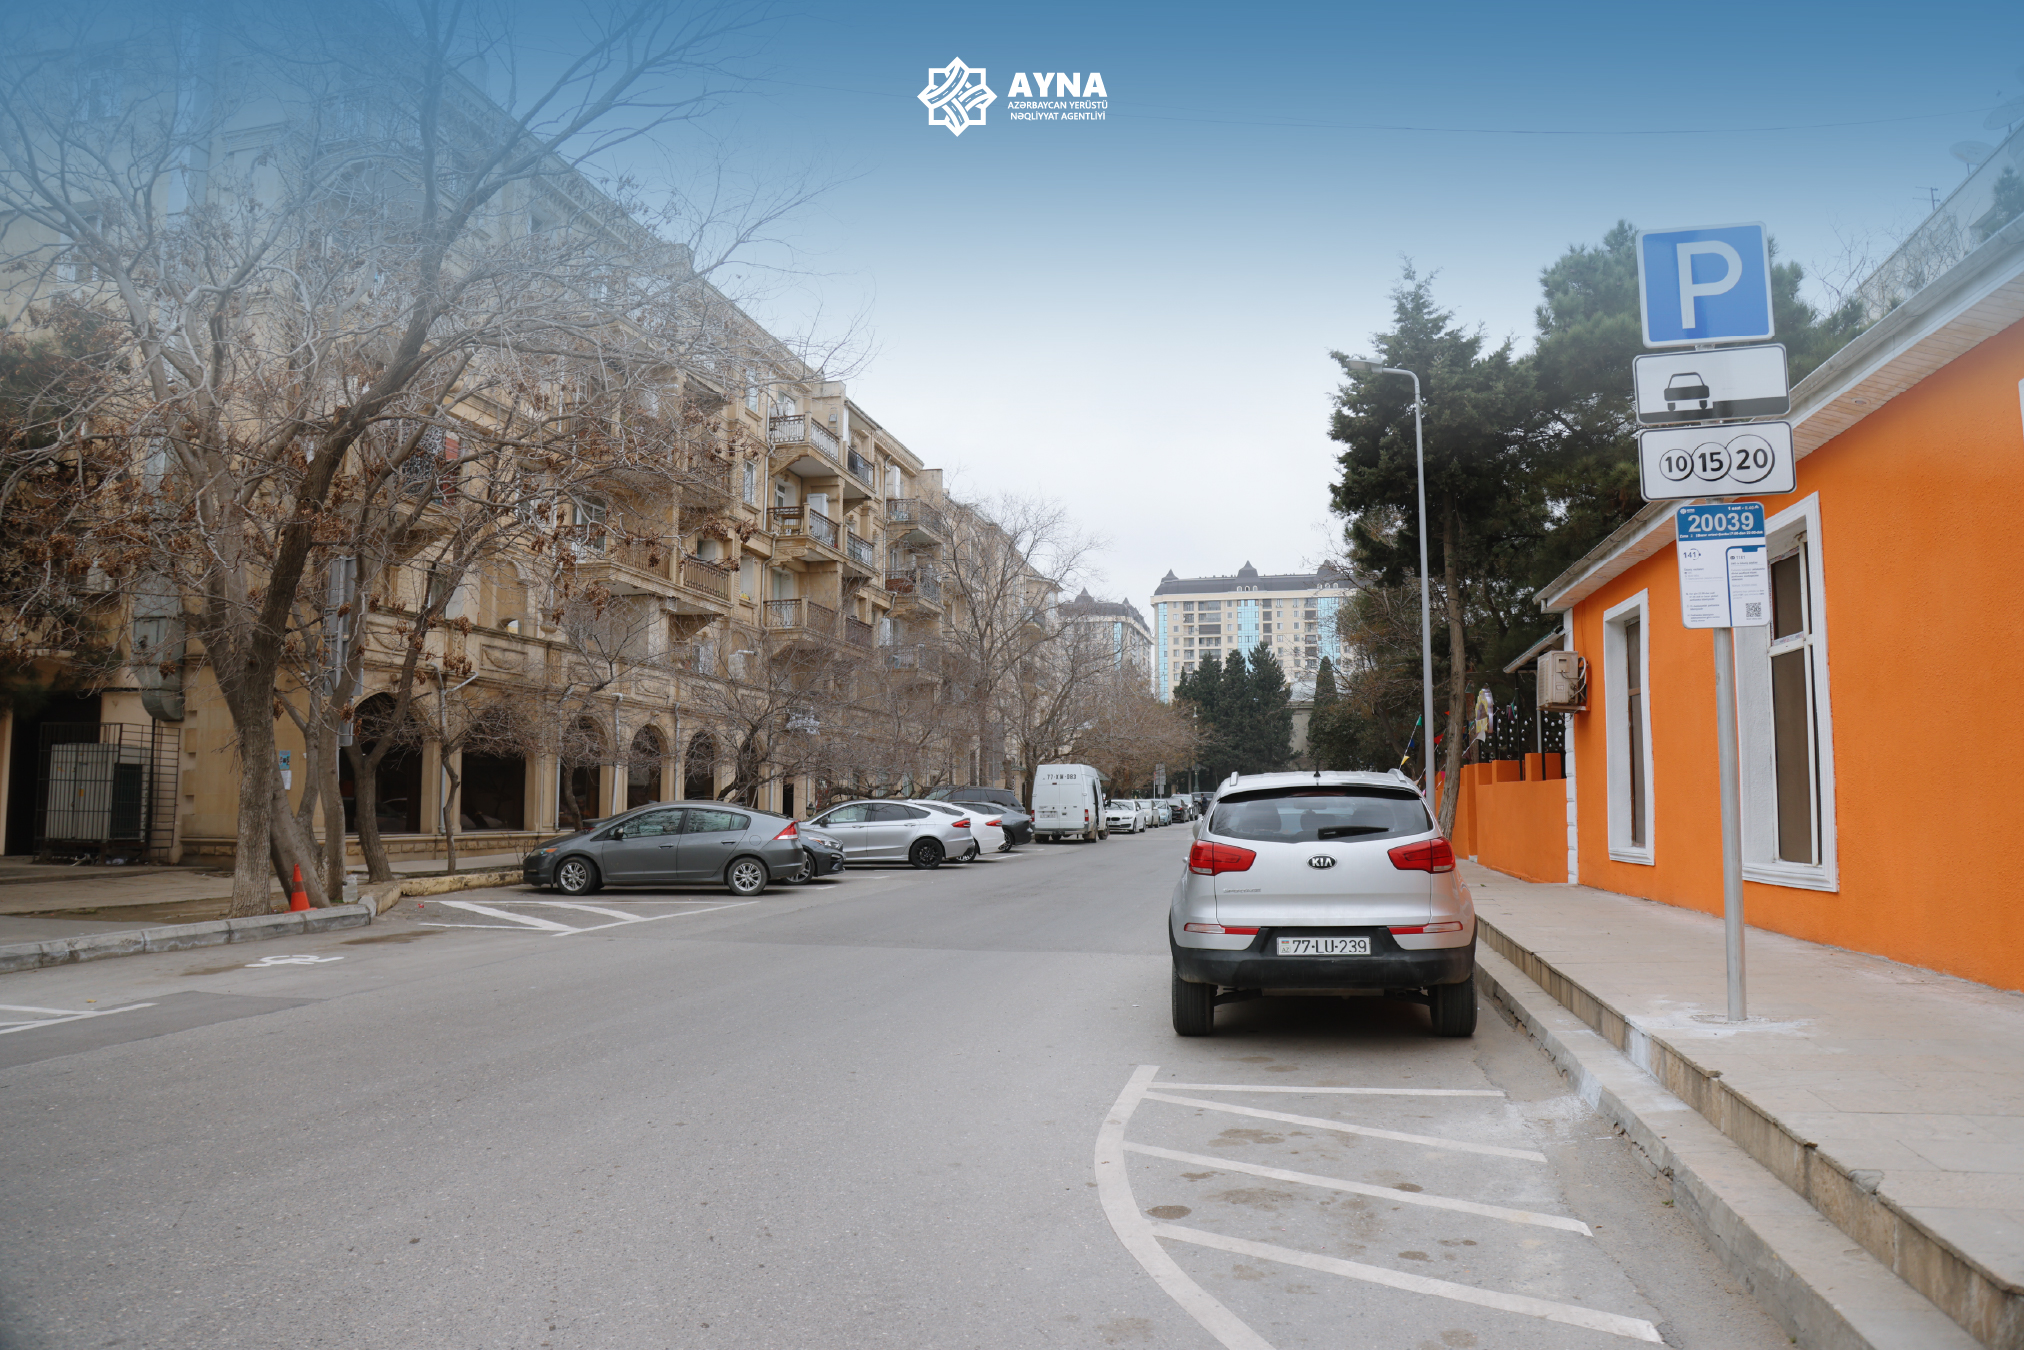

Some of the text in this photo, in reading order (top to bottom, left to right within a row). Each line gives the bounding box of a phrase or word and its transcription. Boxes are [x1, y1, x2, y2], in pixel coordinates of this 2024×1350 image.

[1676, 240, 1743, 329] P
[1664, 448, 1768, 473] 10 15 20
[1688, 512, 1754, 533] 20039
[1311, 857, 1333, 867] KIA
[1292, 939, 1367, 954] 77-LU-239
